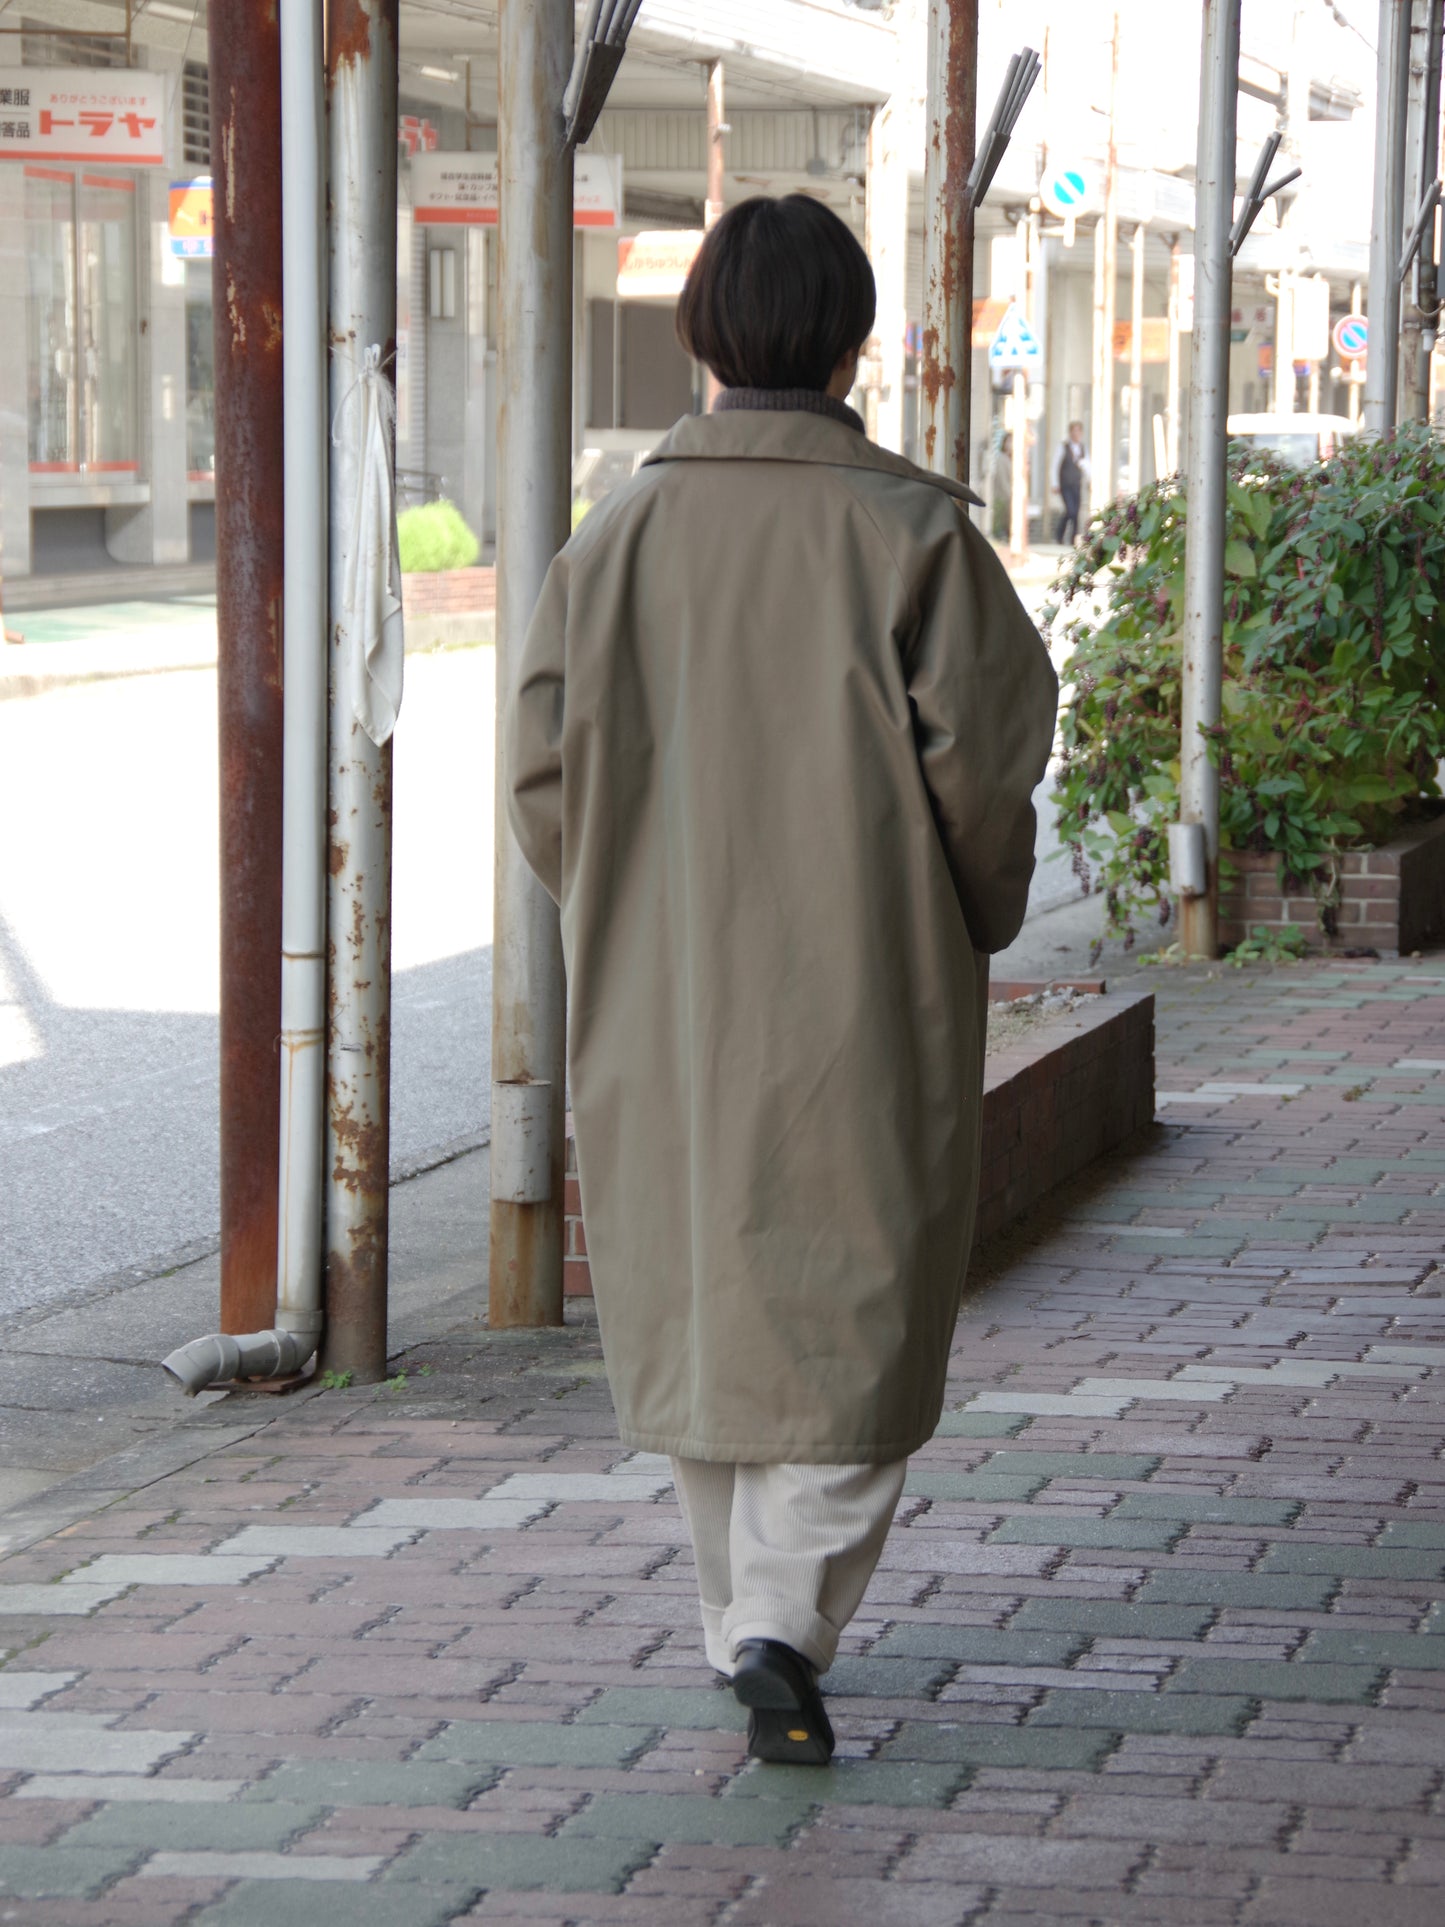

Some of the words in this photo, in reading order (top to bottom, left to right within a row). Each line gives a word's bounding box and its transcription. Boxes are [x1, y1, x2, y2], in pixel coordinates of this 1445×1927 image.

[51, 93, 147, 106] ありがとうございます
[0, 121, 30, 138] 答品
[39, 109, 156, 139] トラヤ
